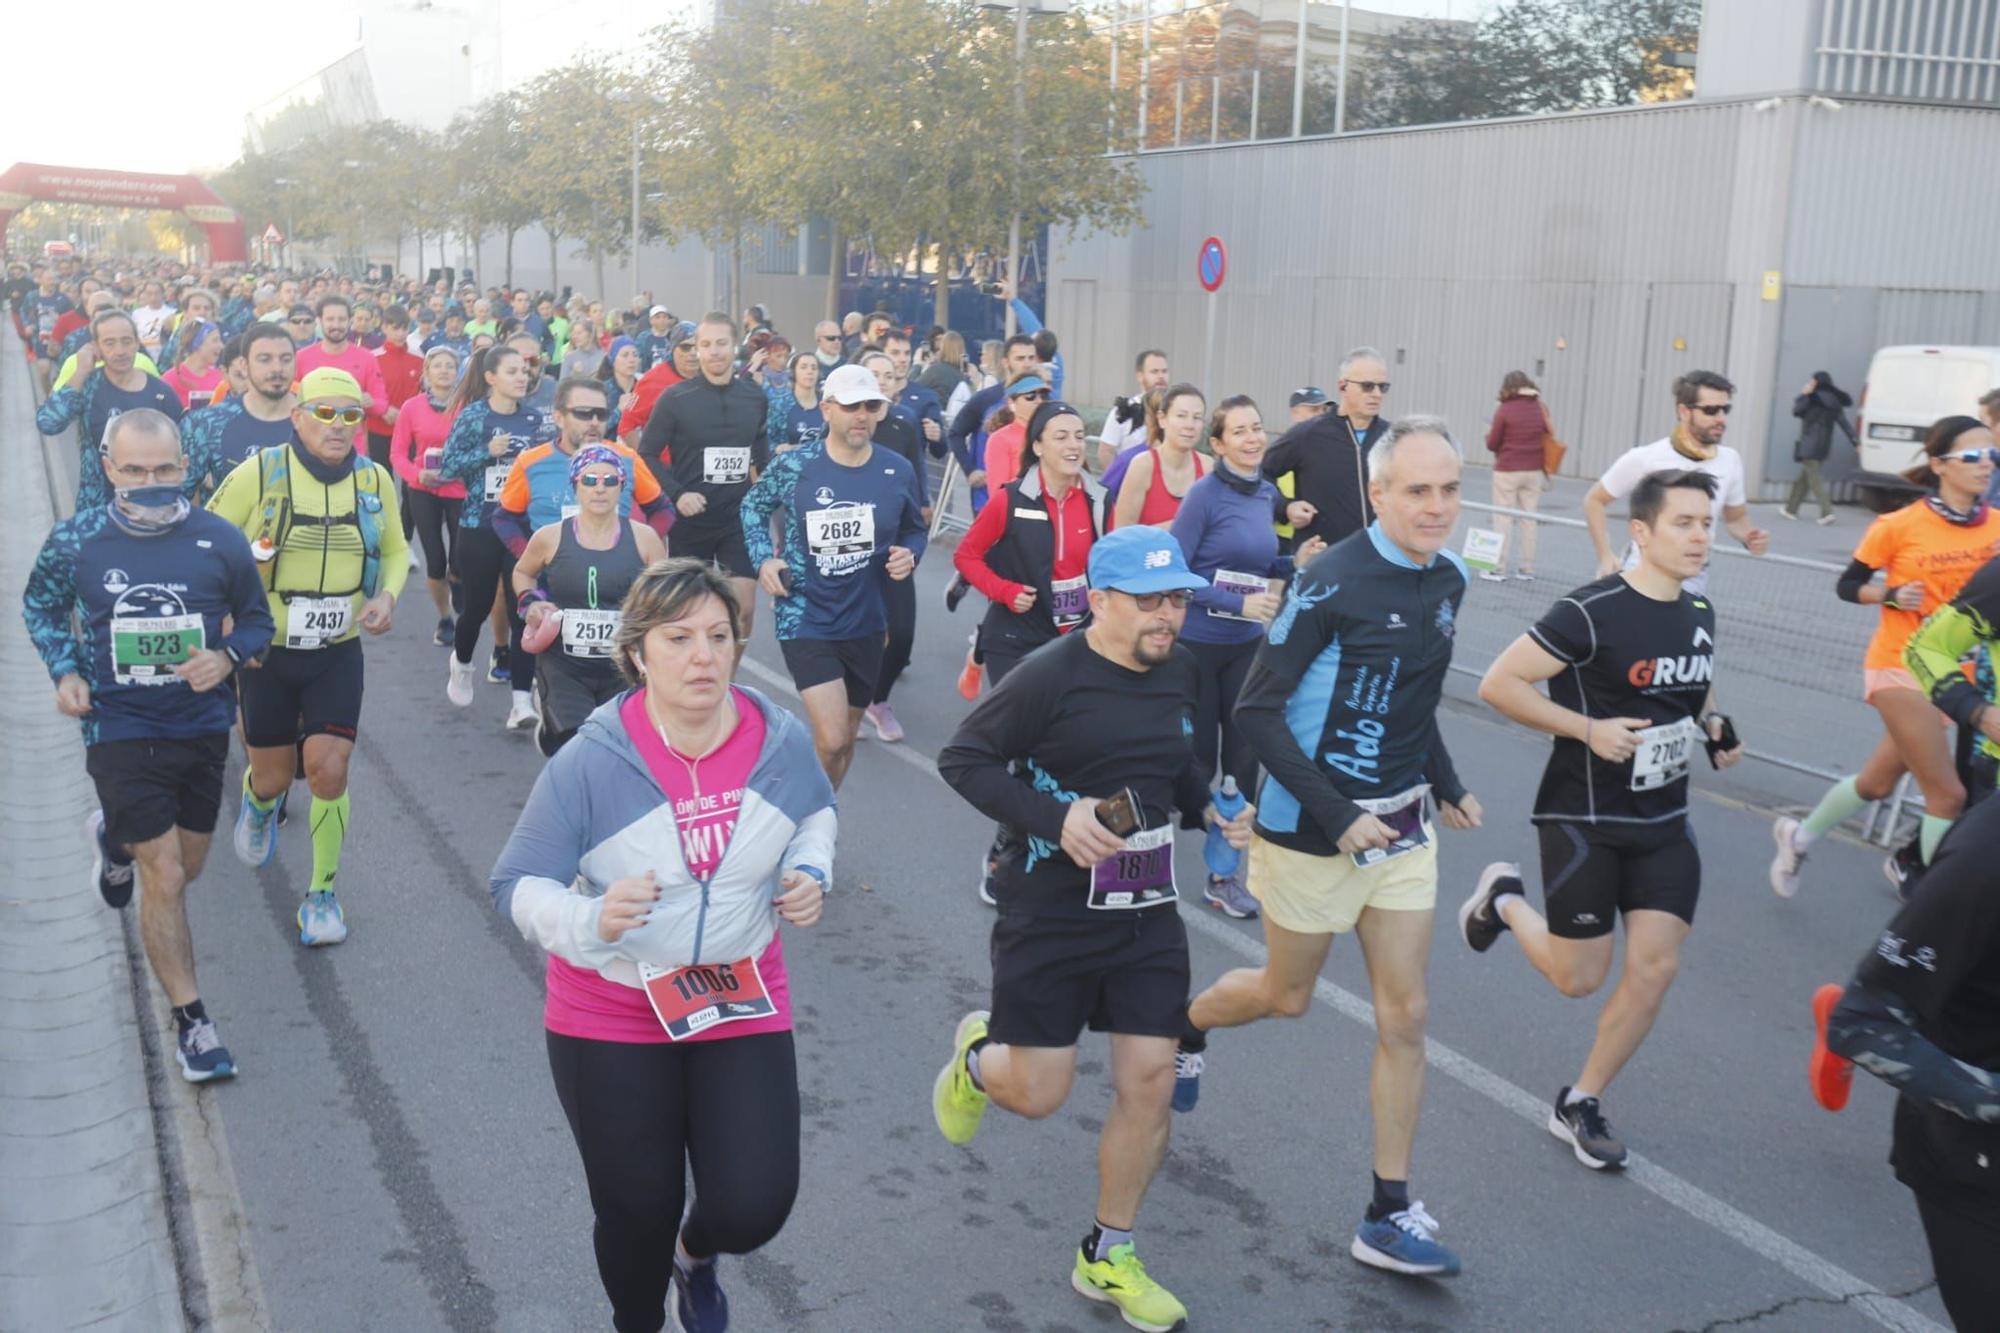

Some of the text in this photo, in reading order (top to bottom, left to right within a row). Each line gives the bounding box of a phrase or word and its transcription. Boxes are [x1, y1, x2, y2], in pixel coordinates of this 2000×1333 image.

[820, 520, 862, 541] 2682
[305, 611, 345, 630] 2437
[575, 622, 614, 641] 2512
[138, 633, 182, 656] 523
[1325, 718, 1386, 784] Ado
[700, 794, 719, 811] DE
